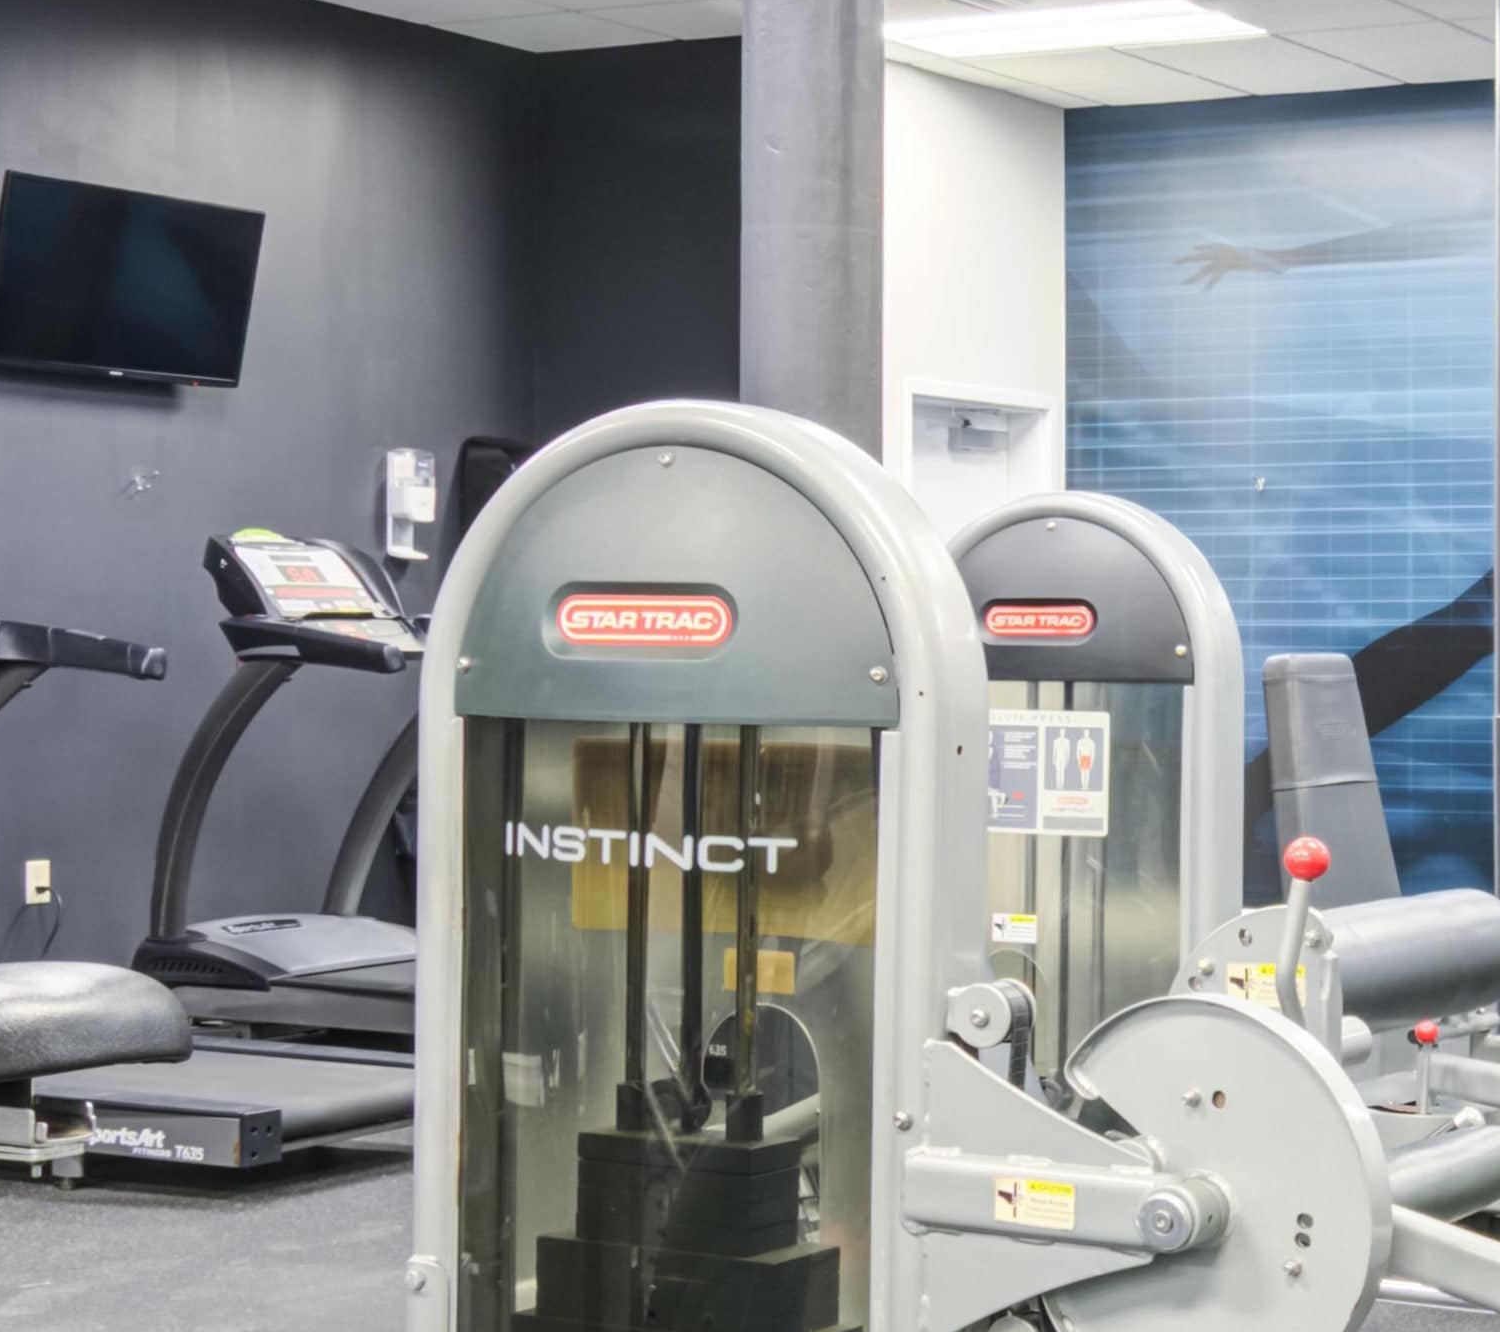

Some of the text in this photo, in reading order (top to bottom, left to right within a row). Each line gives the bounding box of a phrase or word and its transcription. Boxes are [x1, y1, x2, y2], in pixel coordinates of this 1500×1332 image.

[566, 610, 714, 631] STAR TRAC
[994, 614, 1082, 628] STAR TRAC
[505, 820, 798, 874] INSTINCT
[88, 1127, 166, 1148] portsArt
[173, 1144, 205, 1161] T635
